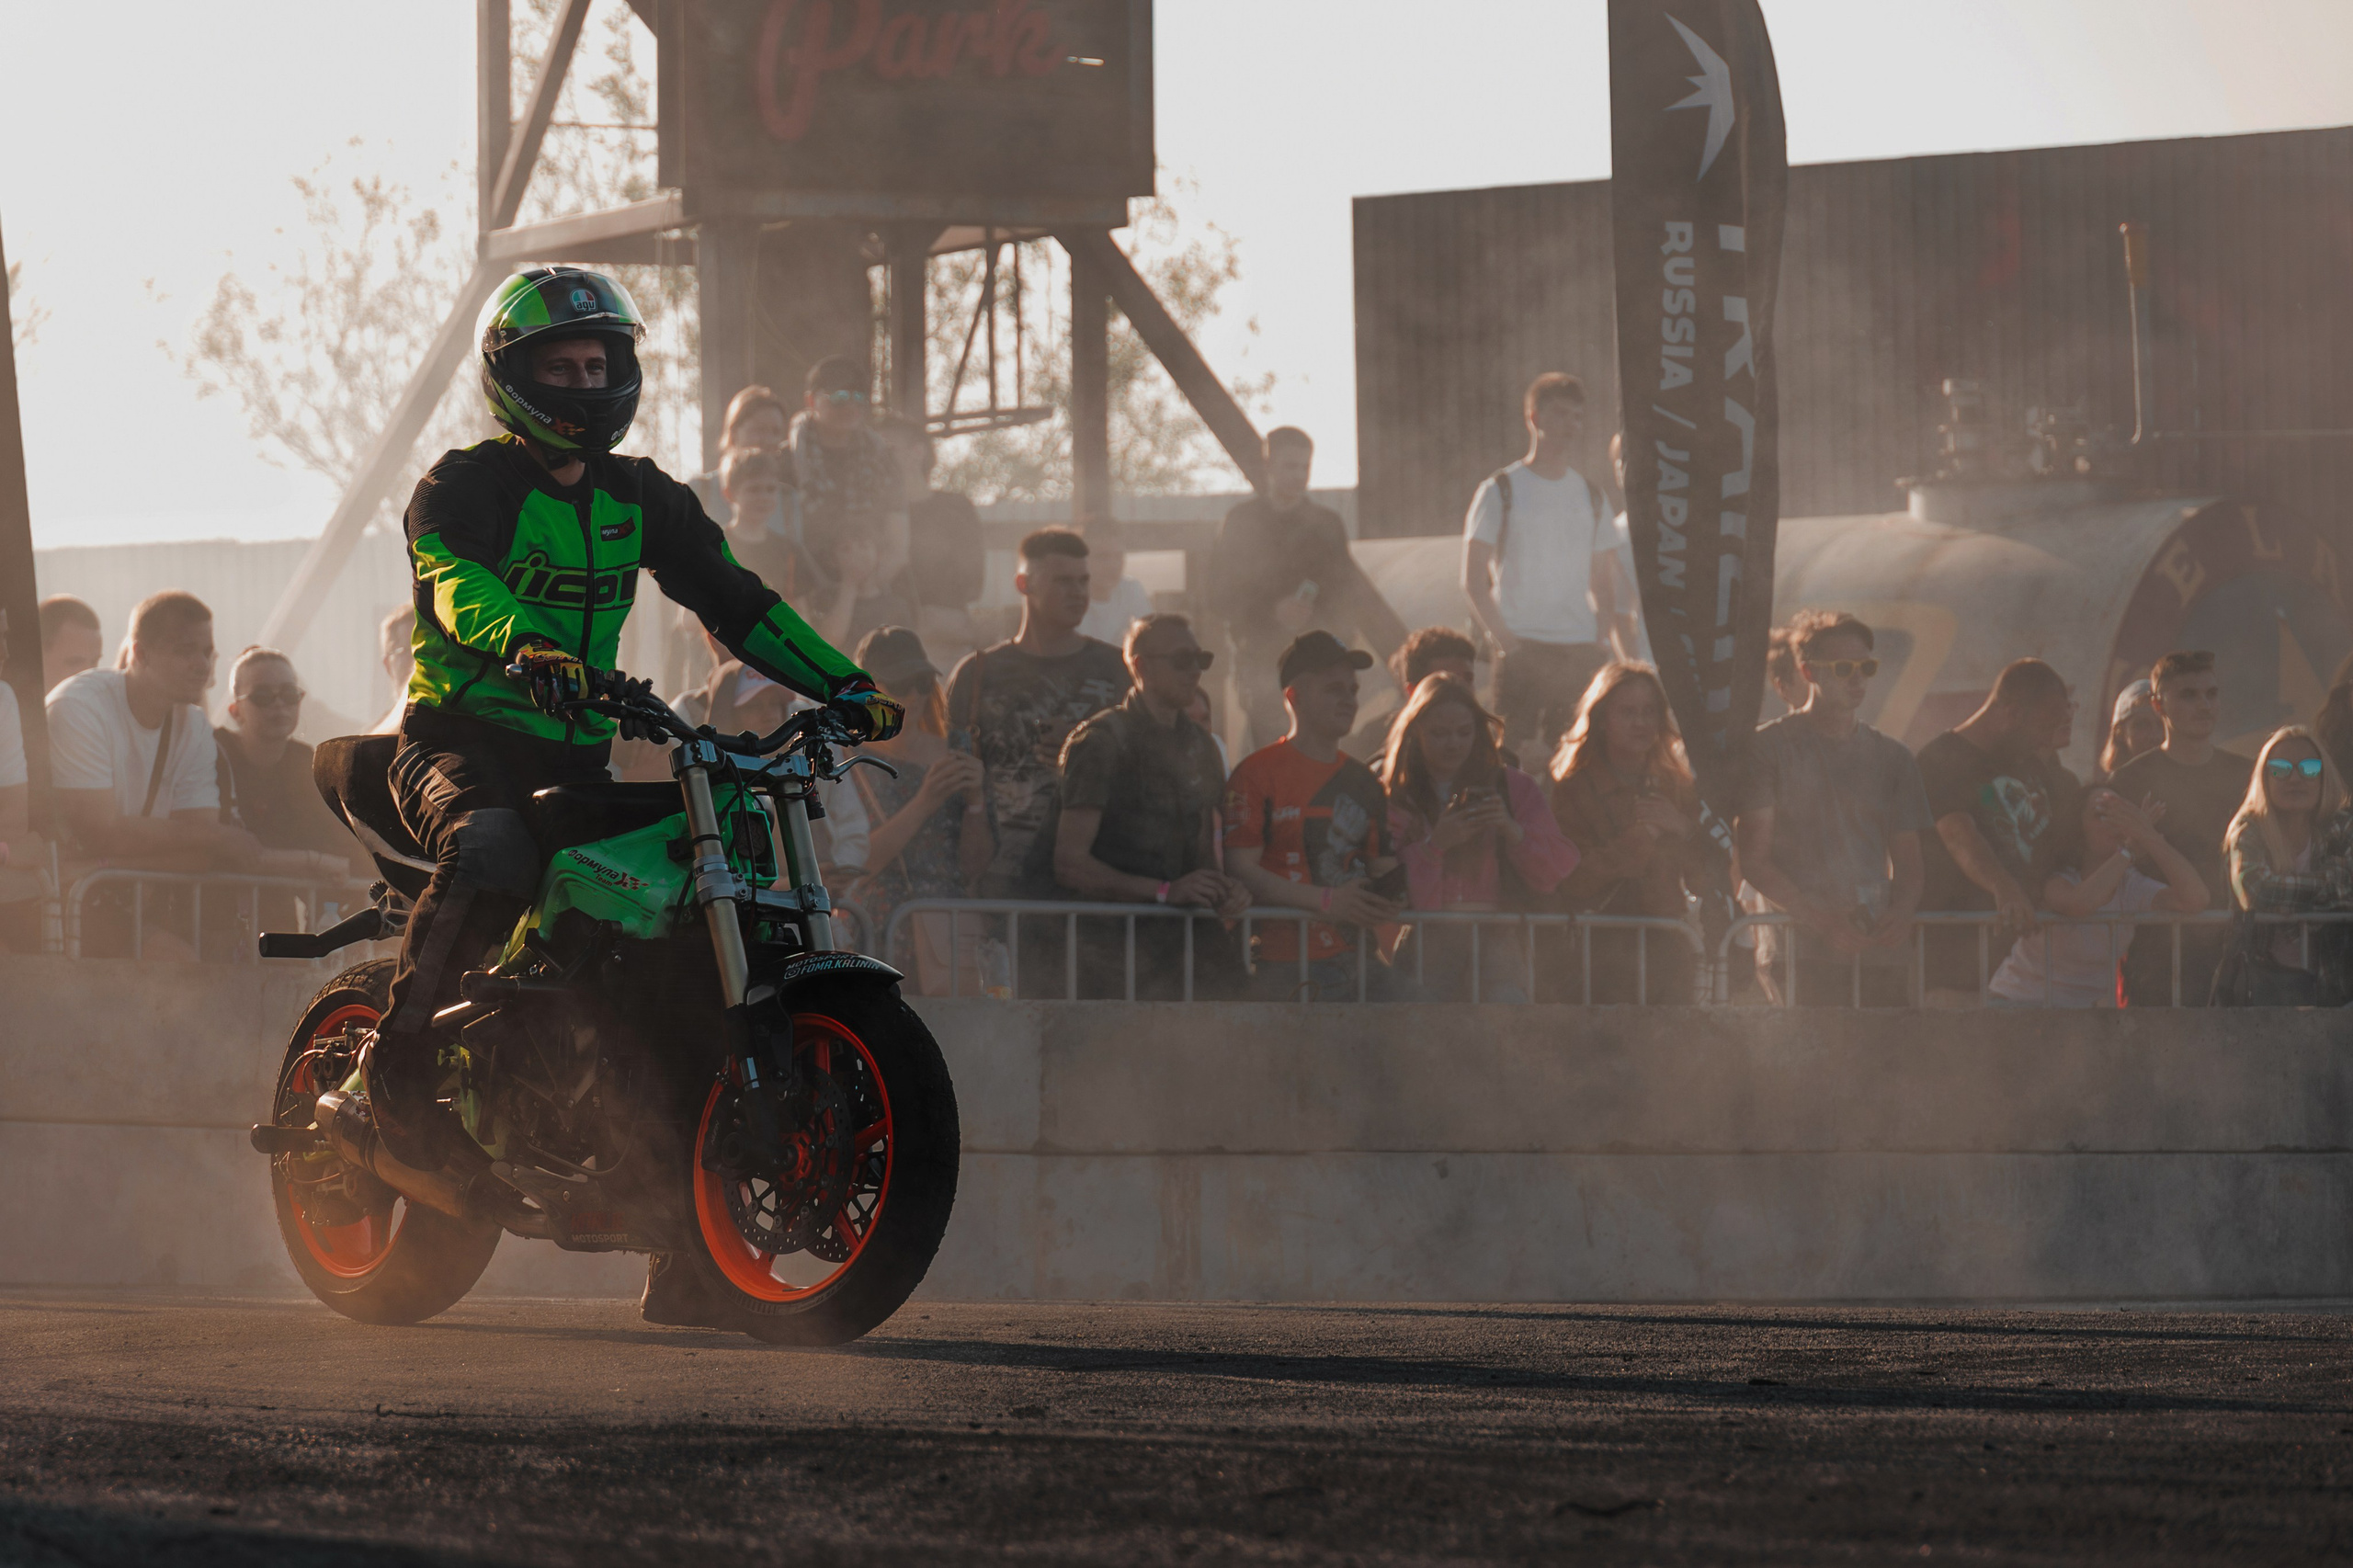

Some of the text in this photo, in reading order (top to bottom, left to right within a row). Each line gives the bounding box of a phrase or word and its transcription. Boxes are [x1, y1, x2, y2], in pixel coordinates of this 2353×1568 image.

[756, 0, 1068, 140] Park
[575, 300, 596, 311] agv
[1660, 221, 1697, 391] RUSSIA
[506, 384, 551, 425] Формула
[1654, 439, 1690, 590] JAPAN
[568, 849, 620, 881] Формула
[596, 874, 613, 887] Team
[786, 954, 856, 971] MOTOSPORT
[801, 959, 881, 975] FOMA.KALININ
[572, 1233, 629, 1244] MOTOSPORT
